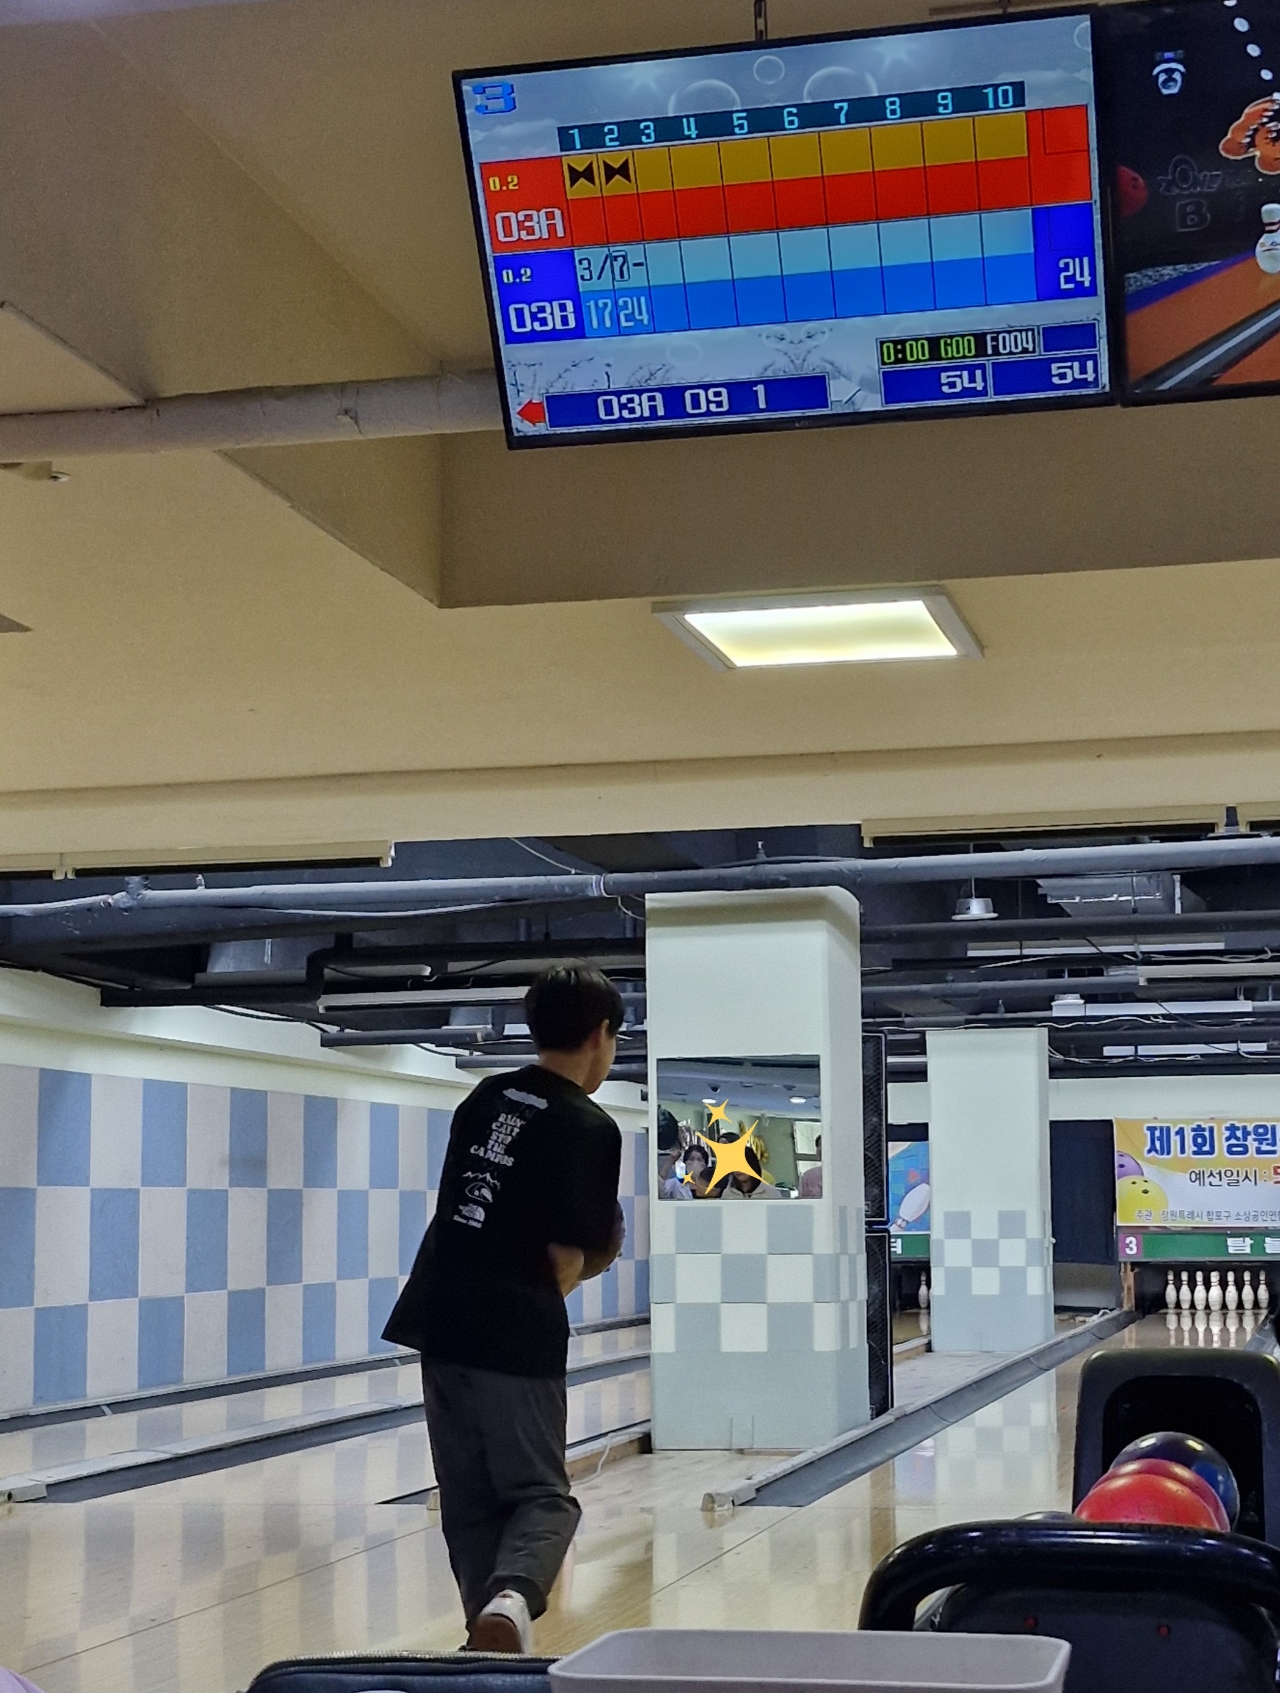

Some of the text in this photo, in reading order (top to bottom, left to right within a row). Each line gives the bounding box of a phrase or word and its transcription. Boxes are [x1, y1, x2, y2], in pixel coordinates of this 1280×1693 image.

[472, 81, 516, 115] 3
[568, 86, 1014, 149] 1 2 3 4 5 6 7 8 9 10
[488, 175, 519, 191] 0.2
[494, 208, 565, 243] 03A
[502, 268, 532, 284] 0.2
[1058, 256, 1092, 289] 24
[508, 300, 576, 333] 03B
[586, 296, 649, 329] 17 24
[882, 330, 1035, 363] 0:00 G00 F004
[940, 360, 1096, 394] 54 54
[597, 384, 766, 420] 03A 09 1
[1145, 1123, 1278, 1156] 제1회 창원
[1189, 1169, 1258, 1187] 예선일시
[1125, 1237, 1138, 1254] 3
